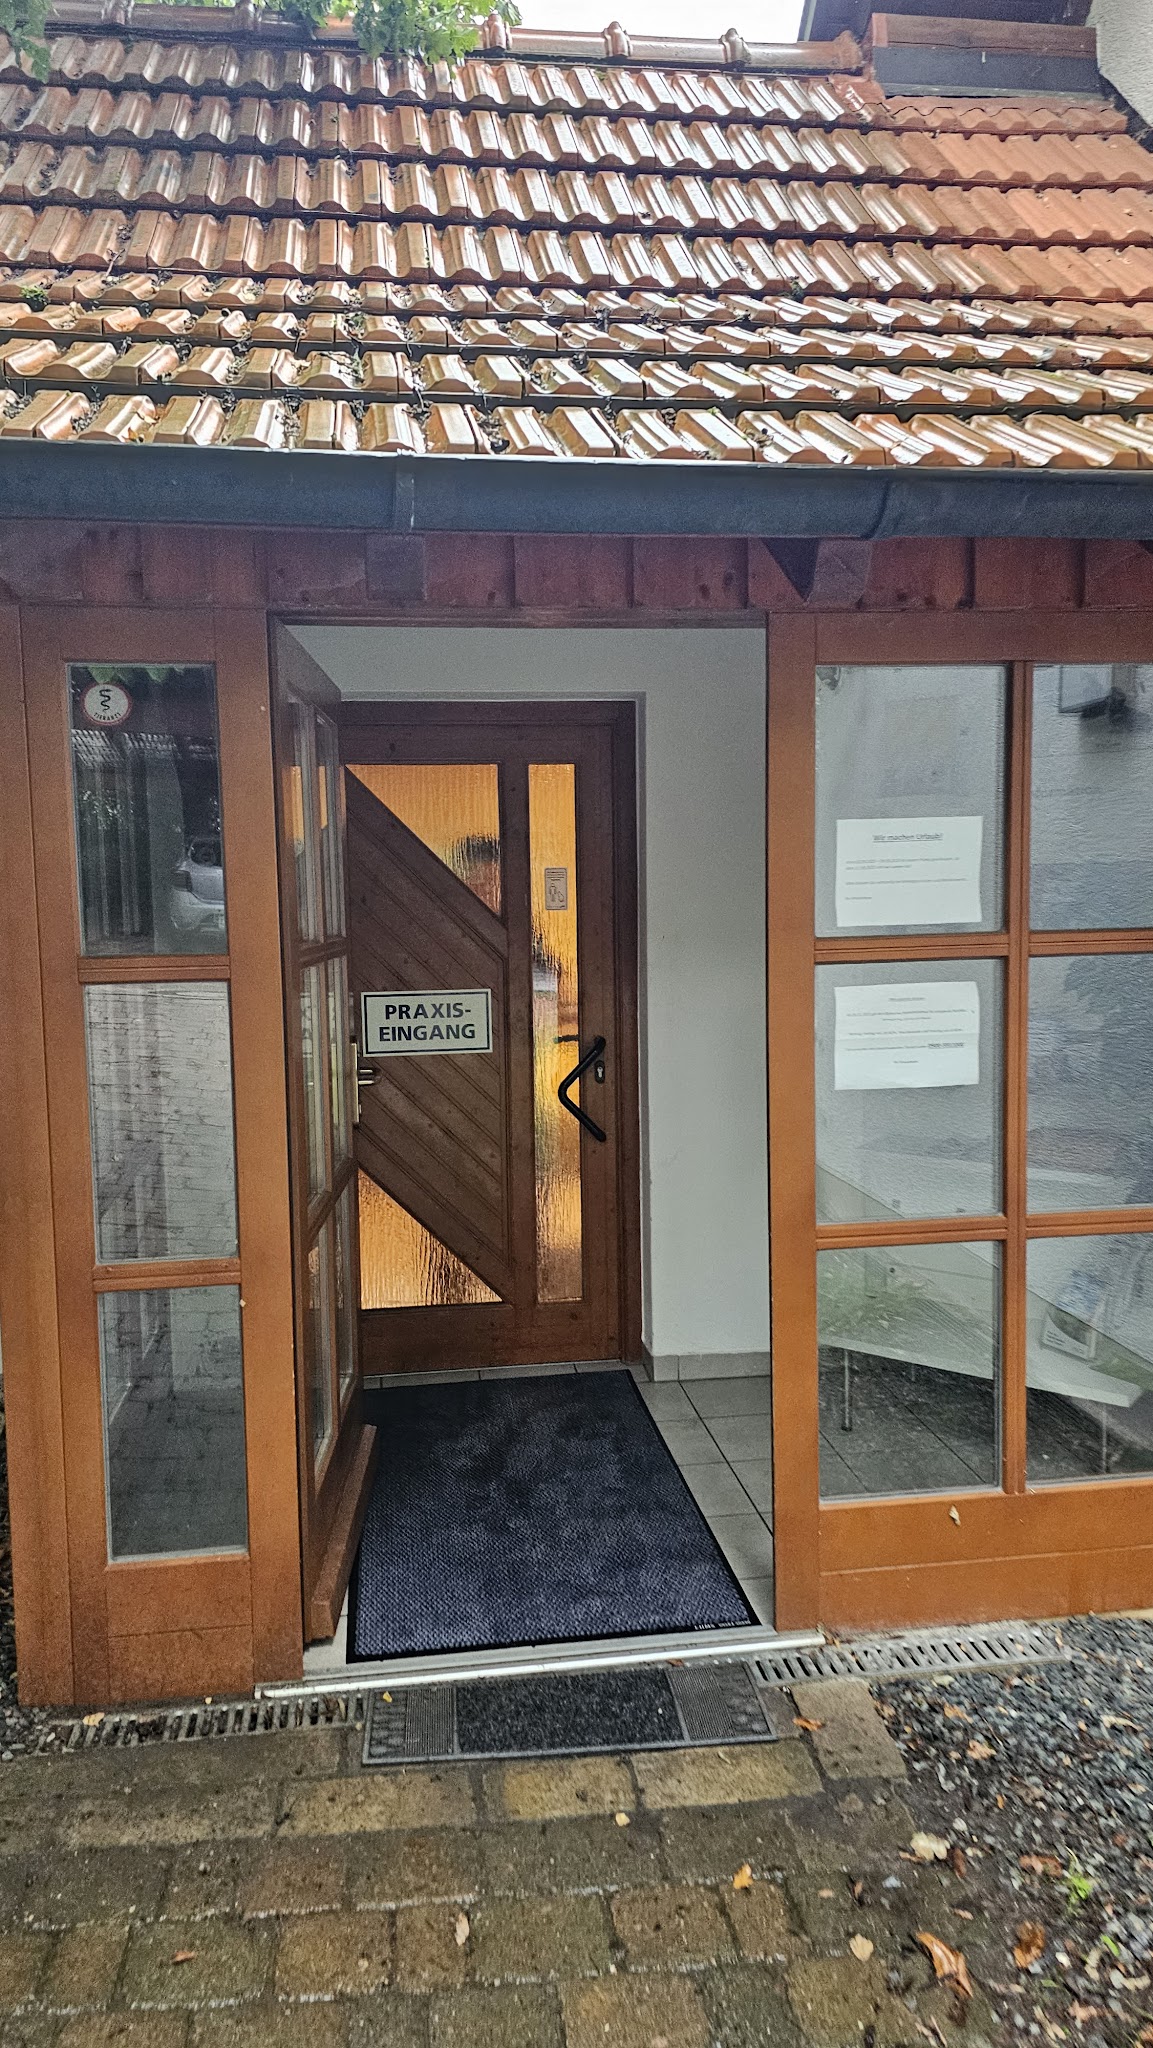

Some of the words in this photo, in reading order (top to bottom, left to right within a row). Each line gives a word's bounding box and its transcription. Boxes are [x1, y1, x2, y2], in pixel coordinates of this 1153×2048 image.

[93, 712, 122, 721] TIERARZT
[385, 1002, 471, 1020] PRAXIS-
[379, 1023, 476, 1042] EINGANG
